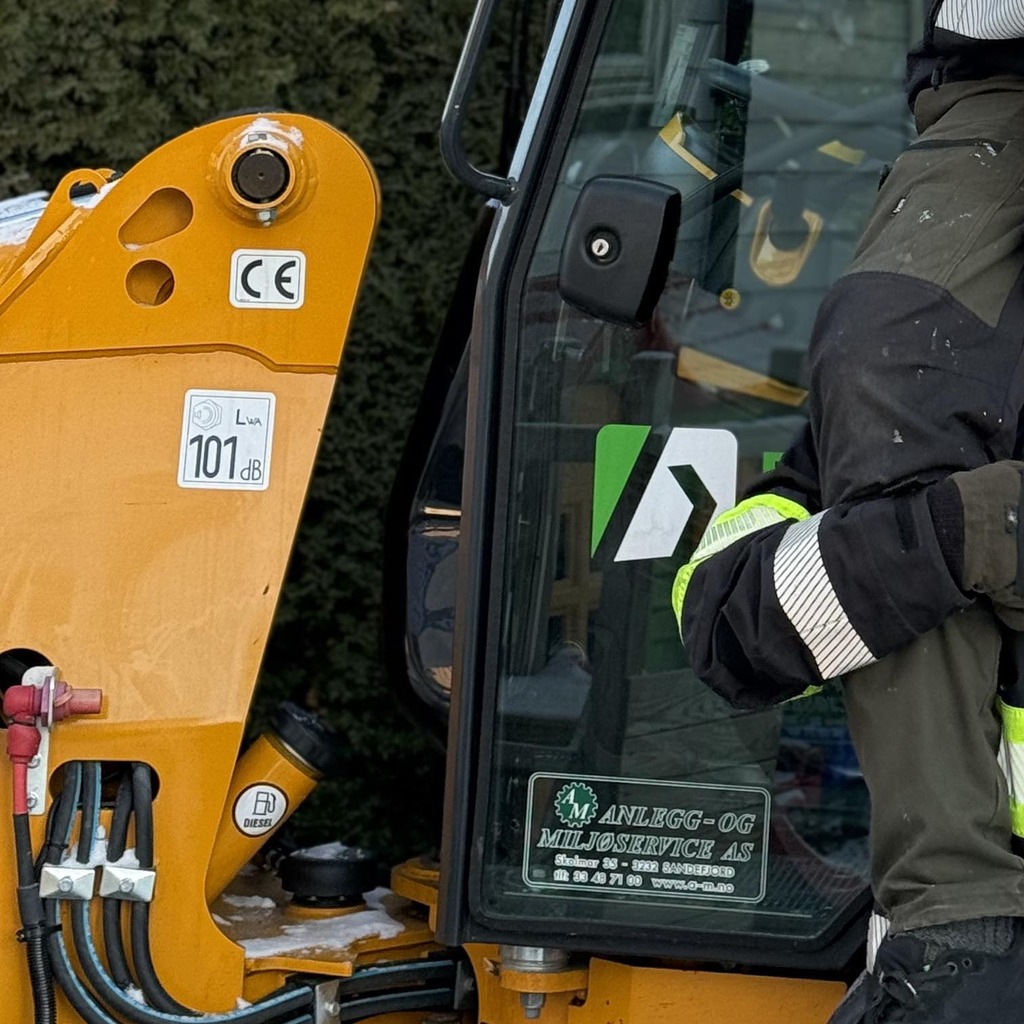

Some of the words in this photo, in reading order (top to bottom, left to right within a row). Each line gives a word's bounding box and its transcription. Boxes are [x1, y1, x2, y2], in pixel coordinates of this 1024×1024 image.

[240, 259, 296, 300] CE
[189, 434, 238, 480] 101
[240, 458, 262, 481] dB
[243, 818, 273, 828] DIESEL
[536, 828, 715, 859] MILJØSERVICE
[720, 842, 755, 862] AS
[631, 859, 659, 873] 3232
[661, 861, 736, 878] SANDEFJORD
